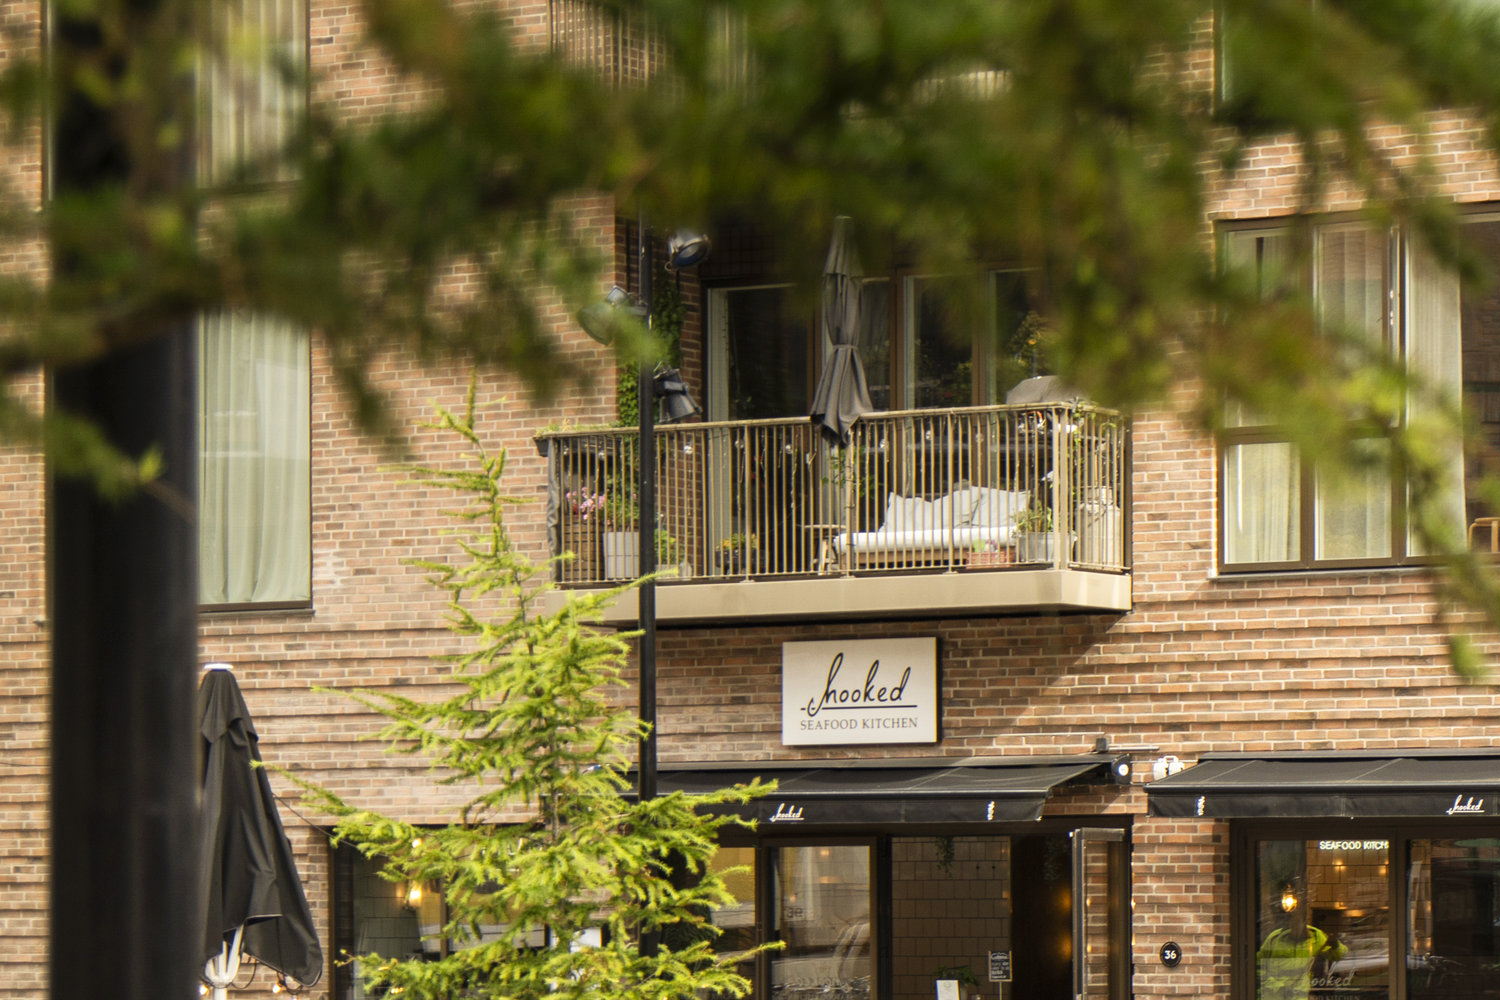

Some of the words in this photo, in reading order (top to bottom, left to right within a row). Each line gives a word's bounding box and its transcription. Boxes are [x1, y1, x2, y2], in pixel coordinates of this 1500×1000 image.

[806, 652, 911, 717] hooked
[800, 719, 858, 731] SEAFOOD
[862, 717, 918, 729] KITCHEN
[1319, 840, 1362, 850] SEAFOOD
[1164, 950, 1177, 960] 36
